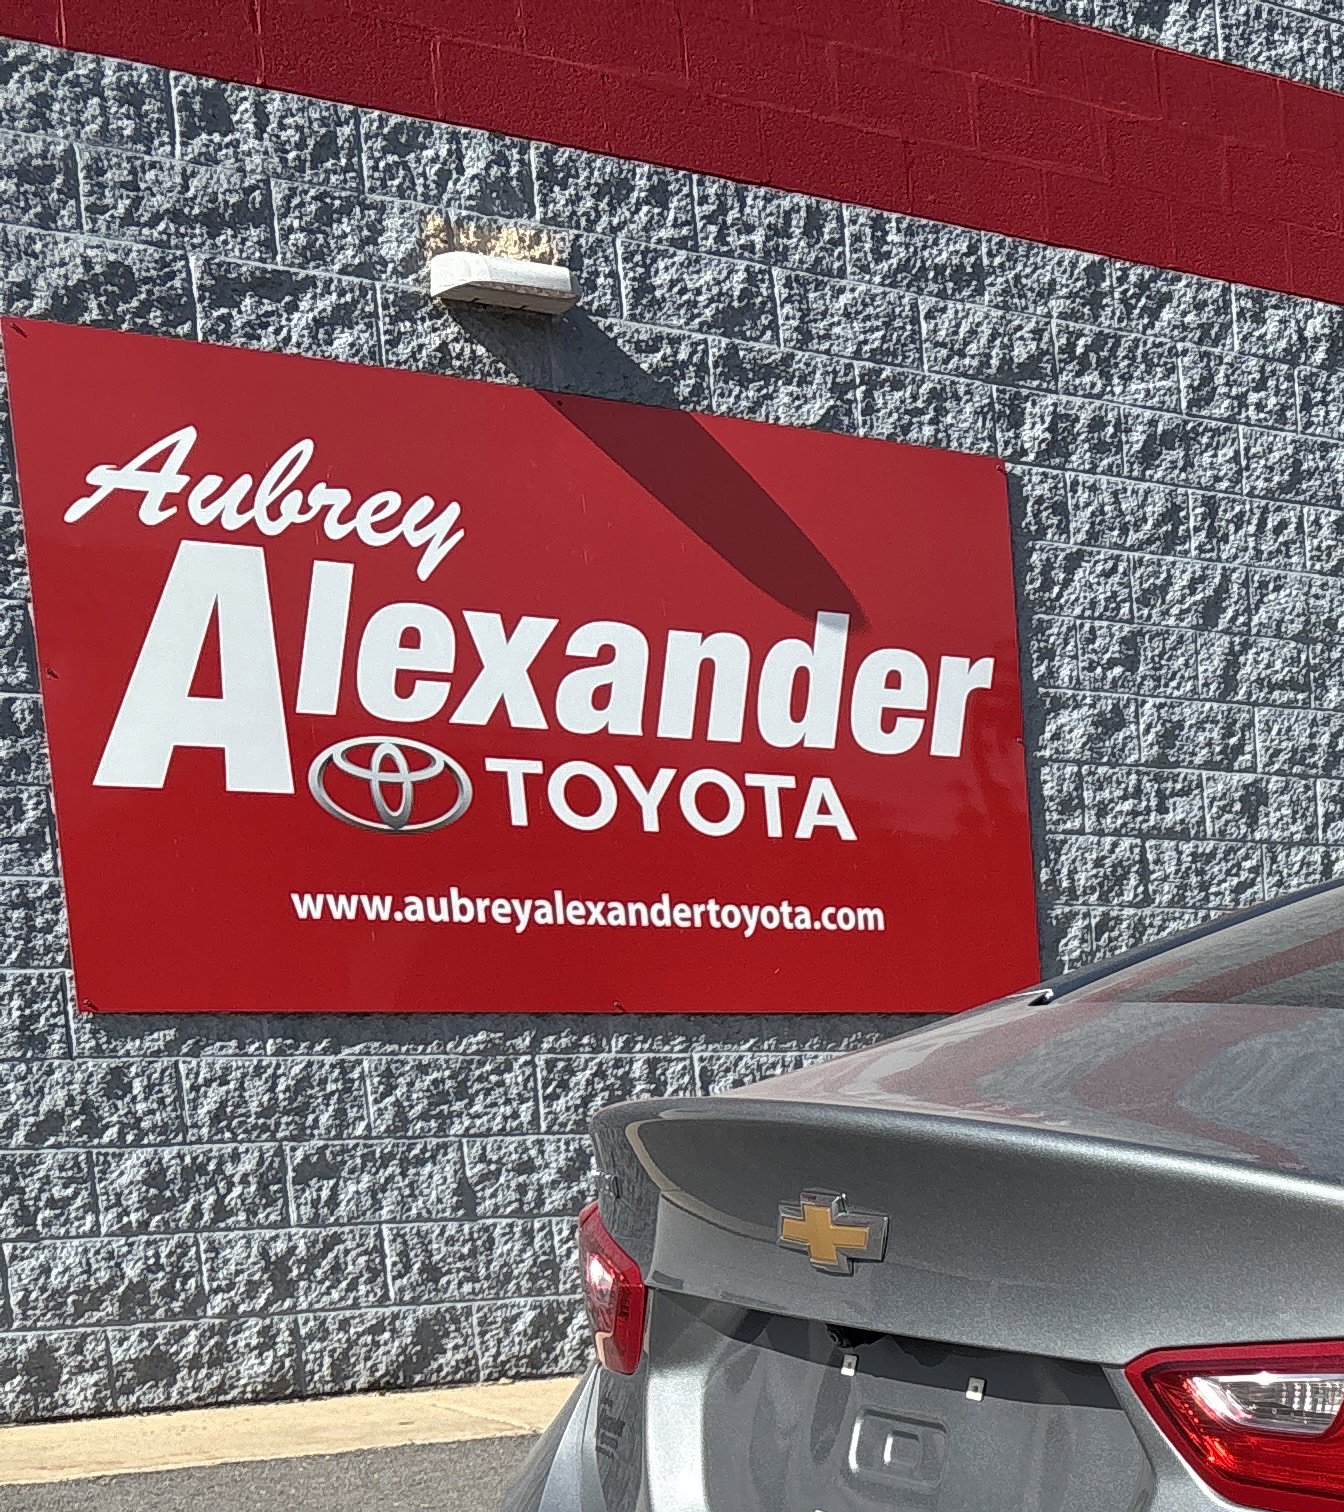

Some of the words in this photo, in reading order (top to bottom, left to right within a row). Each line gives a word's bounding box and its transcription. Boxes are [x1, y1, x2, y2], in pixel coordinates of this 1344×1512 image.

[63, 425, 465, 582] Aubrey
[92, 539, 995, 795] Alexander
[484, 757, 858, 841] TOYOTA
[290, 886, 885, 935] www.aubreyalexandertoyota.com
